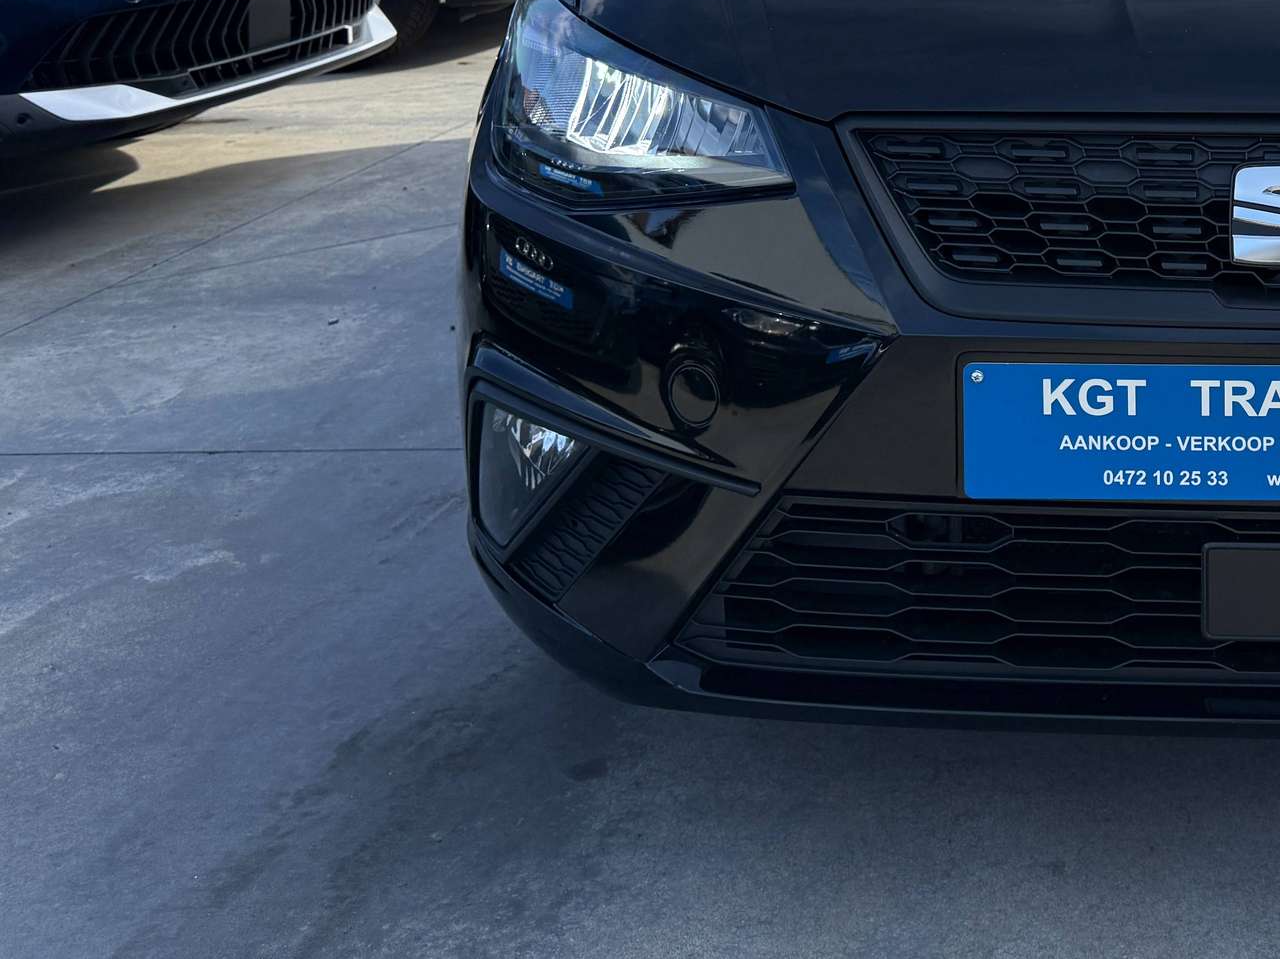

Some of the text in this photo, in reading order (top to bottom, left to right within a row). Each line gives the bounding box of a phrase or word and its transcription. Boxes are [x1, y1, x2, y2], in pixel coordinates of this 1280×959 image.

[1042, 378, 1147, 416] KGT
[1059, 435, 1160, 451] AANKOOP
[1177, 436, 1275, 452] VERKOOP
[1103, 470, 1147, 486] 0472
[1153, 470, 1174, 486] 10
[1179, 470, 1202, 486] 25
[1207, 470, 1229, 486] 33
